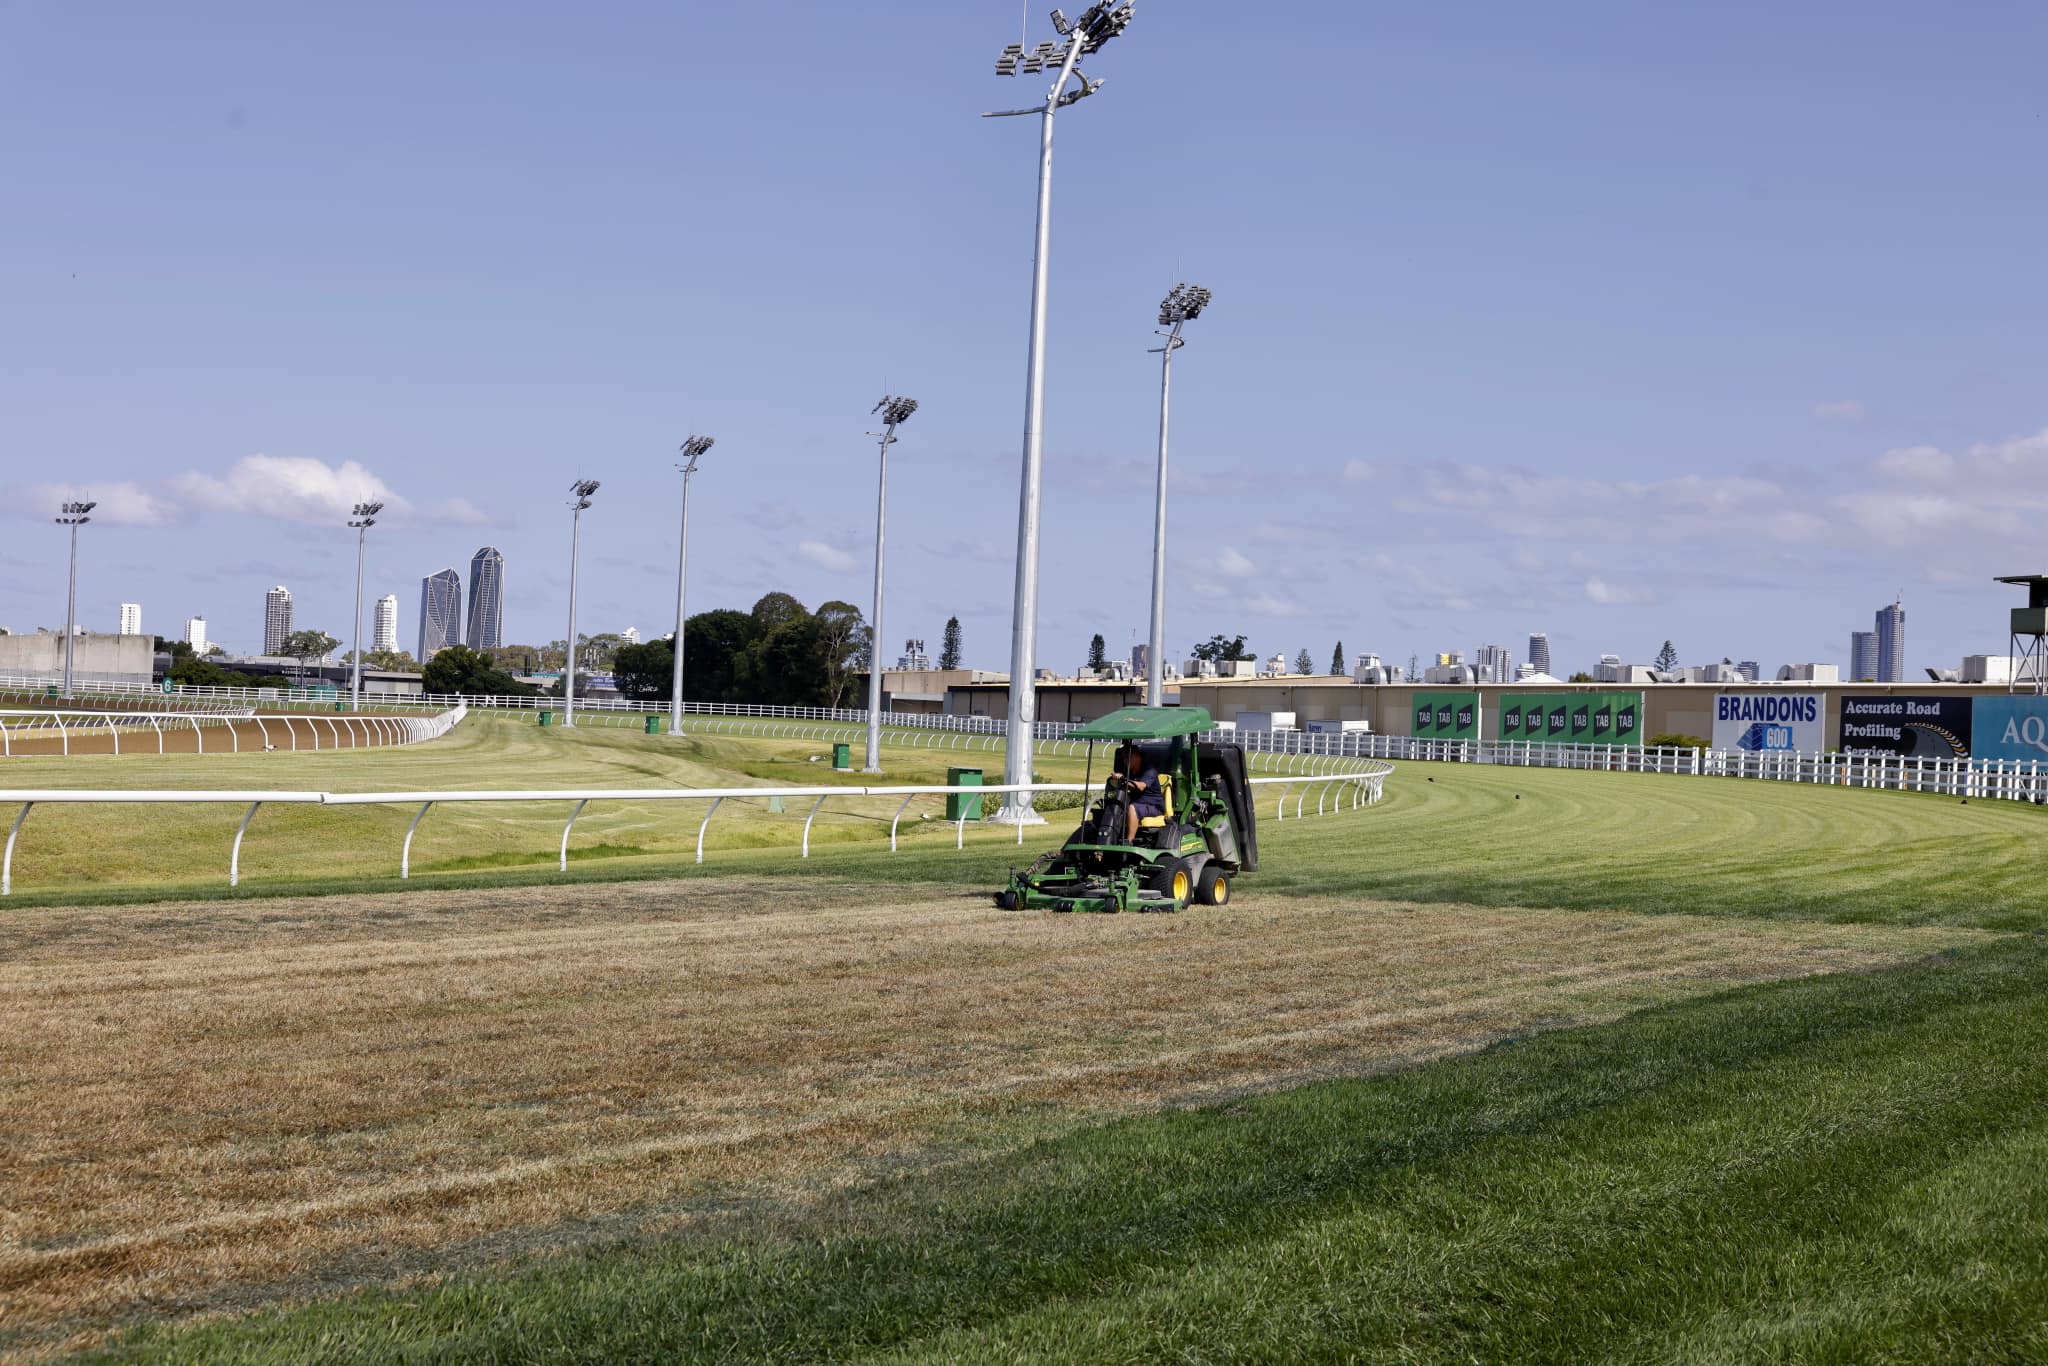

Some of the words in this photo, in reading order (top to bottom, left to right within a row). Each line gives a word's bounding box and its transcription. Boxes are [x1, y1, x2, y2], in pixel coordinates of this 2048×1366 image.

[164, 679, 171, 692] 6
[1719, 696, 1817, 722] BRANDONS
[1845, 701, 1903, 715] Accurate
[1906, 702, 1941, 716] Road
[1418, 711, 1431, 723] TAB
[1438, 712, 1451, 724] TAB
[1458, 712, 1472, 724] TAB
[1506, 714, 1520, 726] TAB
[1527, 715, 1541, 726] TAB
[1550, 715, 1564, 727] TAB
[1573, 714, 1587, 726] TAB
[1596, 715, 1609, 727] TAB
[1618, 715, 1633, 728] TAB
[1766, 728, 1788, 748] 600
[1844, 724, 1902, 741] Profiling
[1844, 745, 1896, 757] Services
